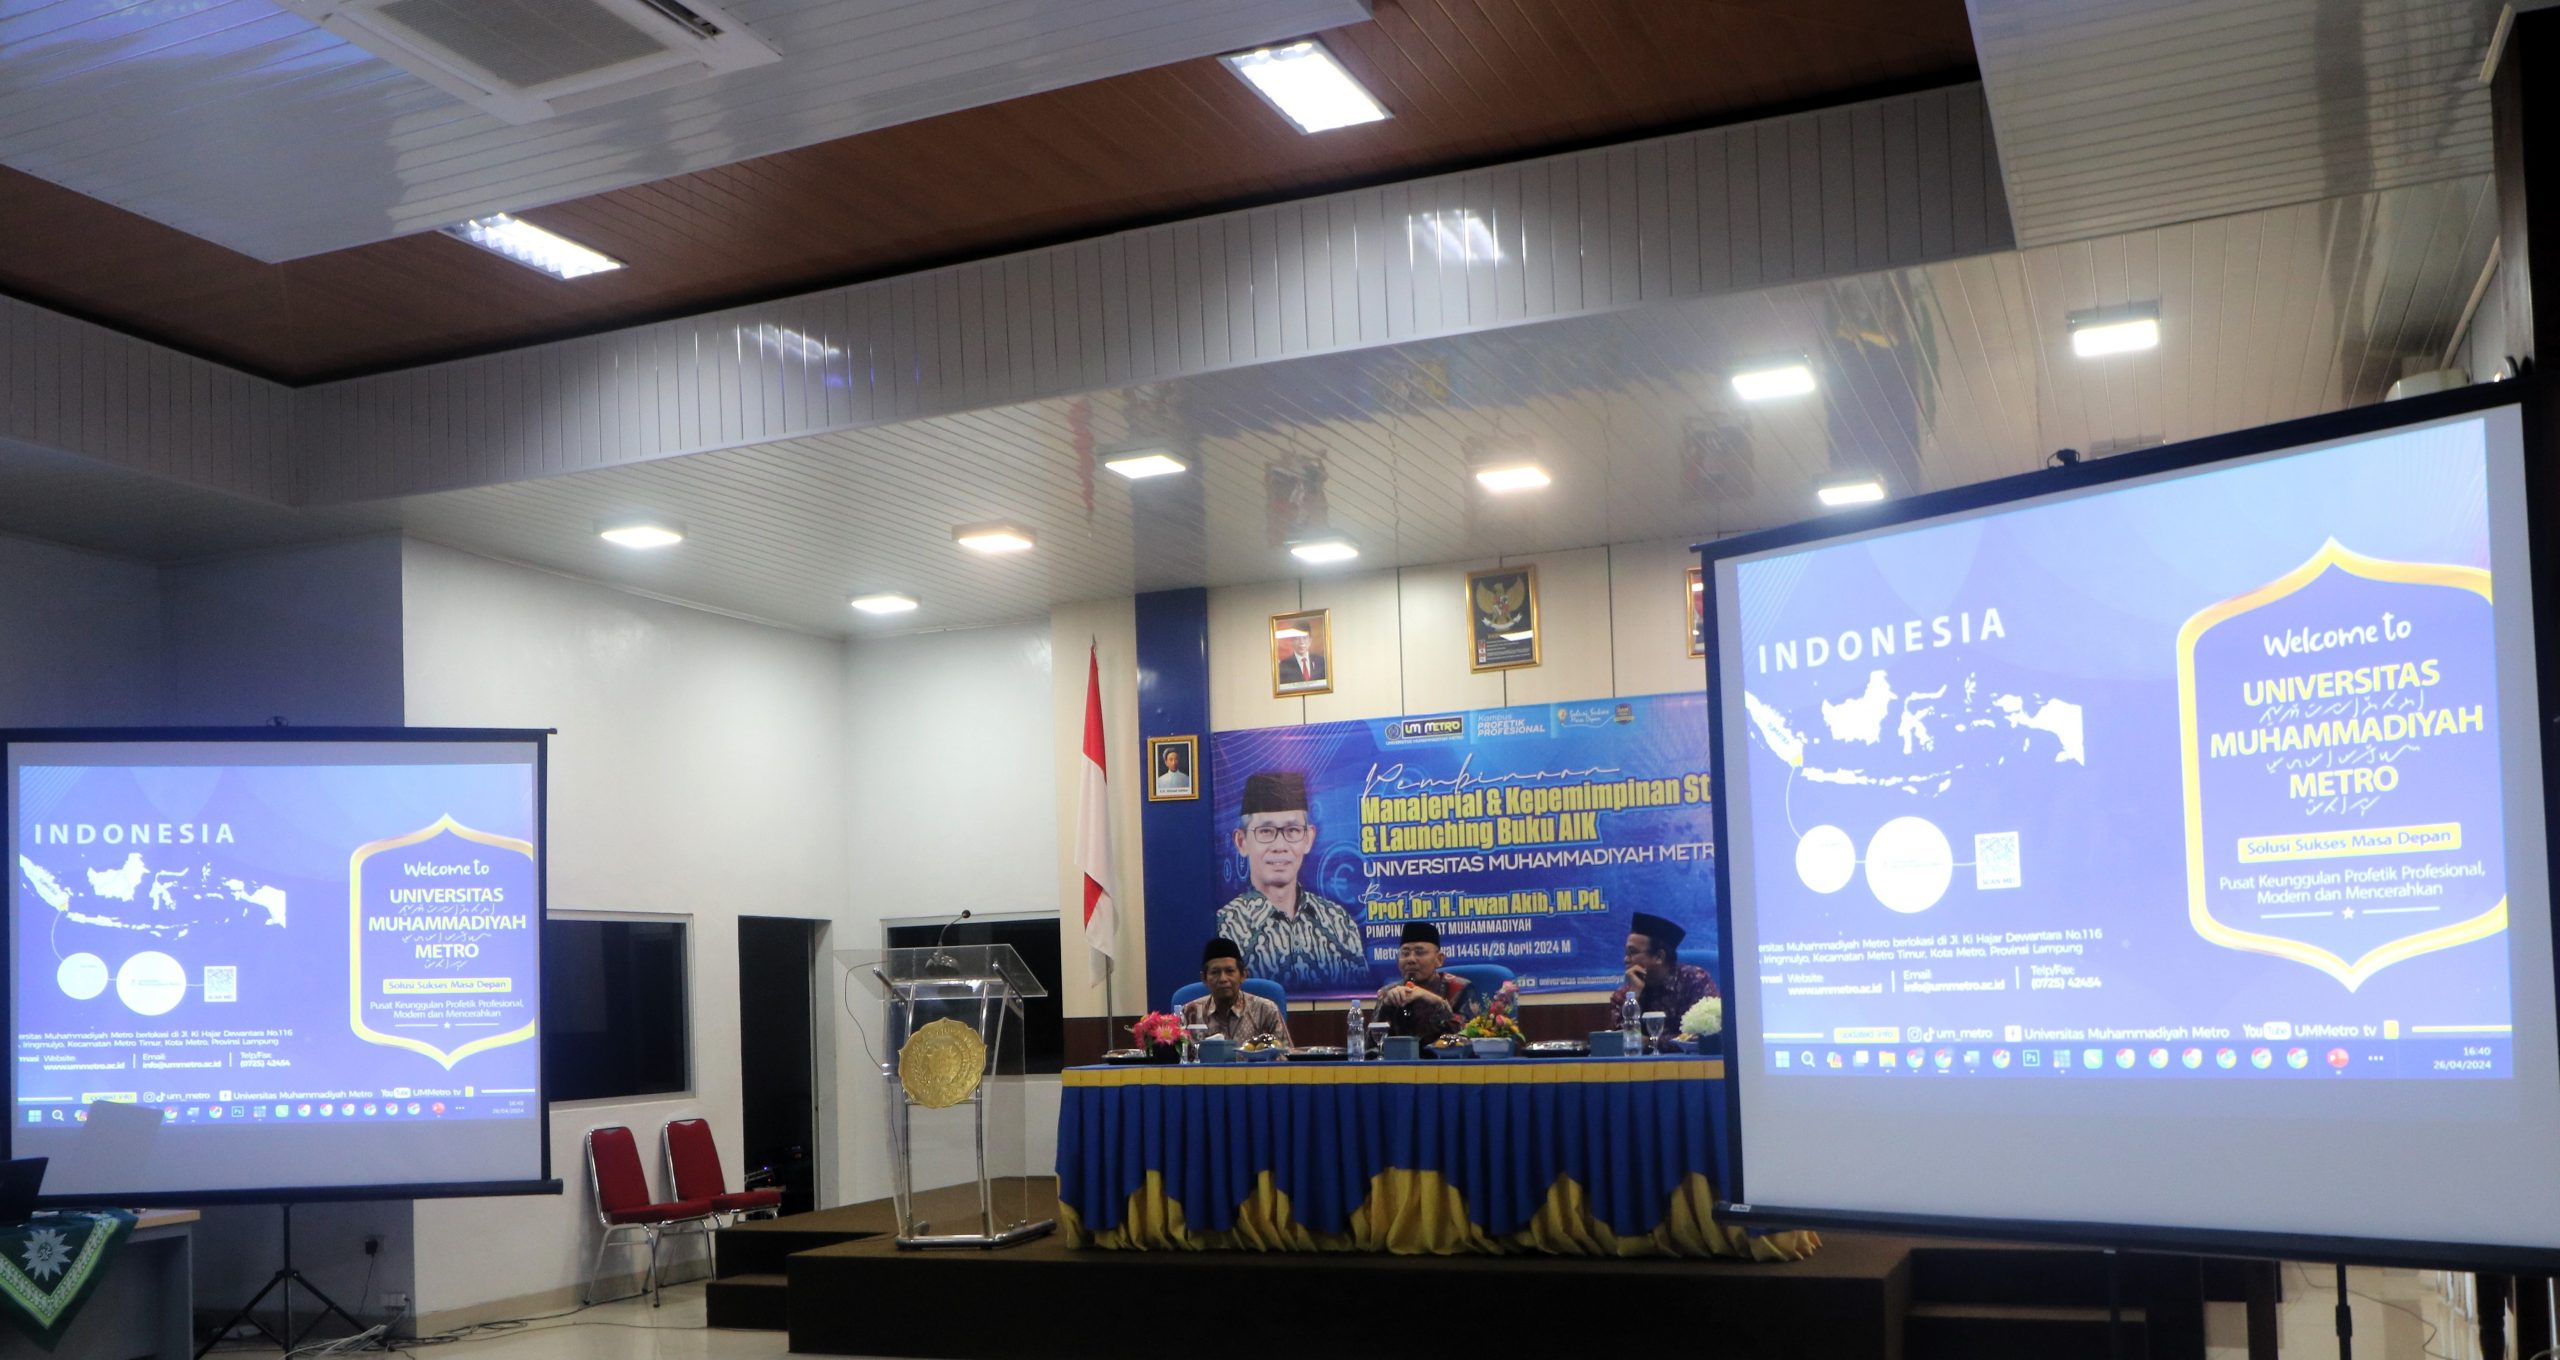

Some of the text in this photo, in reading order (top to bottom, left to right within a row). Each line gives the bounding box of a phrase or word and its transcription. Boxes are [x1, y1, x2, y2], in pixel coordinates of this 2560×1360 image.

[1758, 607, 2006, 674] INDONESIA
[2263, 611, 2412, 658] Welcome to
[2243, 658, 2441, 707] UNIVERSITAS
[1424, 721, 1461, 734] METRO
[1477, 719, 1526, 730] PROFETIK
[1477, 724, 1546, 737] PROFESIONAL
[2210, 704, 2484, 759] MUHAMMADIYAH
[1361, 752, 1621, 802] Pembinaan
[2289, 765, 2399, 800] METRO
[1360, 788, 1483, 825] Manajerial
[1486, 787, 1502, 817] &
[1504, 777, 1681, 816] Kepemimpinan
[34, 823, 235, 845] INDONESIA
[1361, 811, 1598, 854] & Launching Buku AIK
[2247, 831, 2451, 855] Solusi Sukses Masa Depan
[403, 858, 490, 877] Welcome to
[1363, 842, 1715, 878] UNIVERSITAS MUHAMMADIYAH METR
[2219, 860, 2486, 890] Pusat Keunggulan Profetik Profesional,
[389, 886, 504, 904] UNIVERSITAS
[2257, 882, 2443, 905] Modern dan Mencerahkan
[1367, 888, 1606, 921] Prof. Dr. H. Irwan Akib, M.Pd.
[368, 914, 527, 932] MUHAMMADIYAH
[1366, 923, 1403, 939] PIMPIN
[1448, 918, 1532, 936] MUHAMMADIYAH
[415, 942, 480, 959] METRO
[1374, 947, 1399, 961] Metr
[1457, 943, 1480, 958] 1445
[1482, 942, 1506, 957] H/26
[1507, 941, 1532, 957] April
[1534, 940, 1559, 955] 2024
[1561, 939, 1571, 954] M
[1862, 938, 1890, 949] Metro
[1937, 934, 1947, 946] di
[1866, 949, 1895, 961] Metro
[1930, 948, 1953, 959] Kota
[369, 1000, 393, 1010] Pusat
[395, 1000, 443, 1012] Keunggulan
[446, 999, 476, 1009] Profetik
[427, 1009, 444, 1018] dan
[446, 1008, 501, 1018] Mencerahkan
[2024, 1025, 2230, 1042] Universitas Muhammadiyah Metro
[2294, 1024, 2359, 1038] UMMetro
[2363, 1024, 2377, 1037] tv
[2433, 1059, 2492, 1070] 26/04/2024
[232, 1089, 373, 1100] Universitas Muhammadiyah Metro
